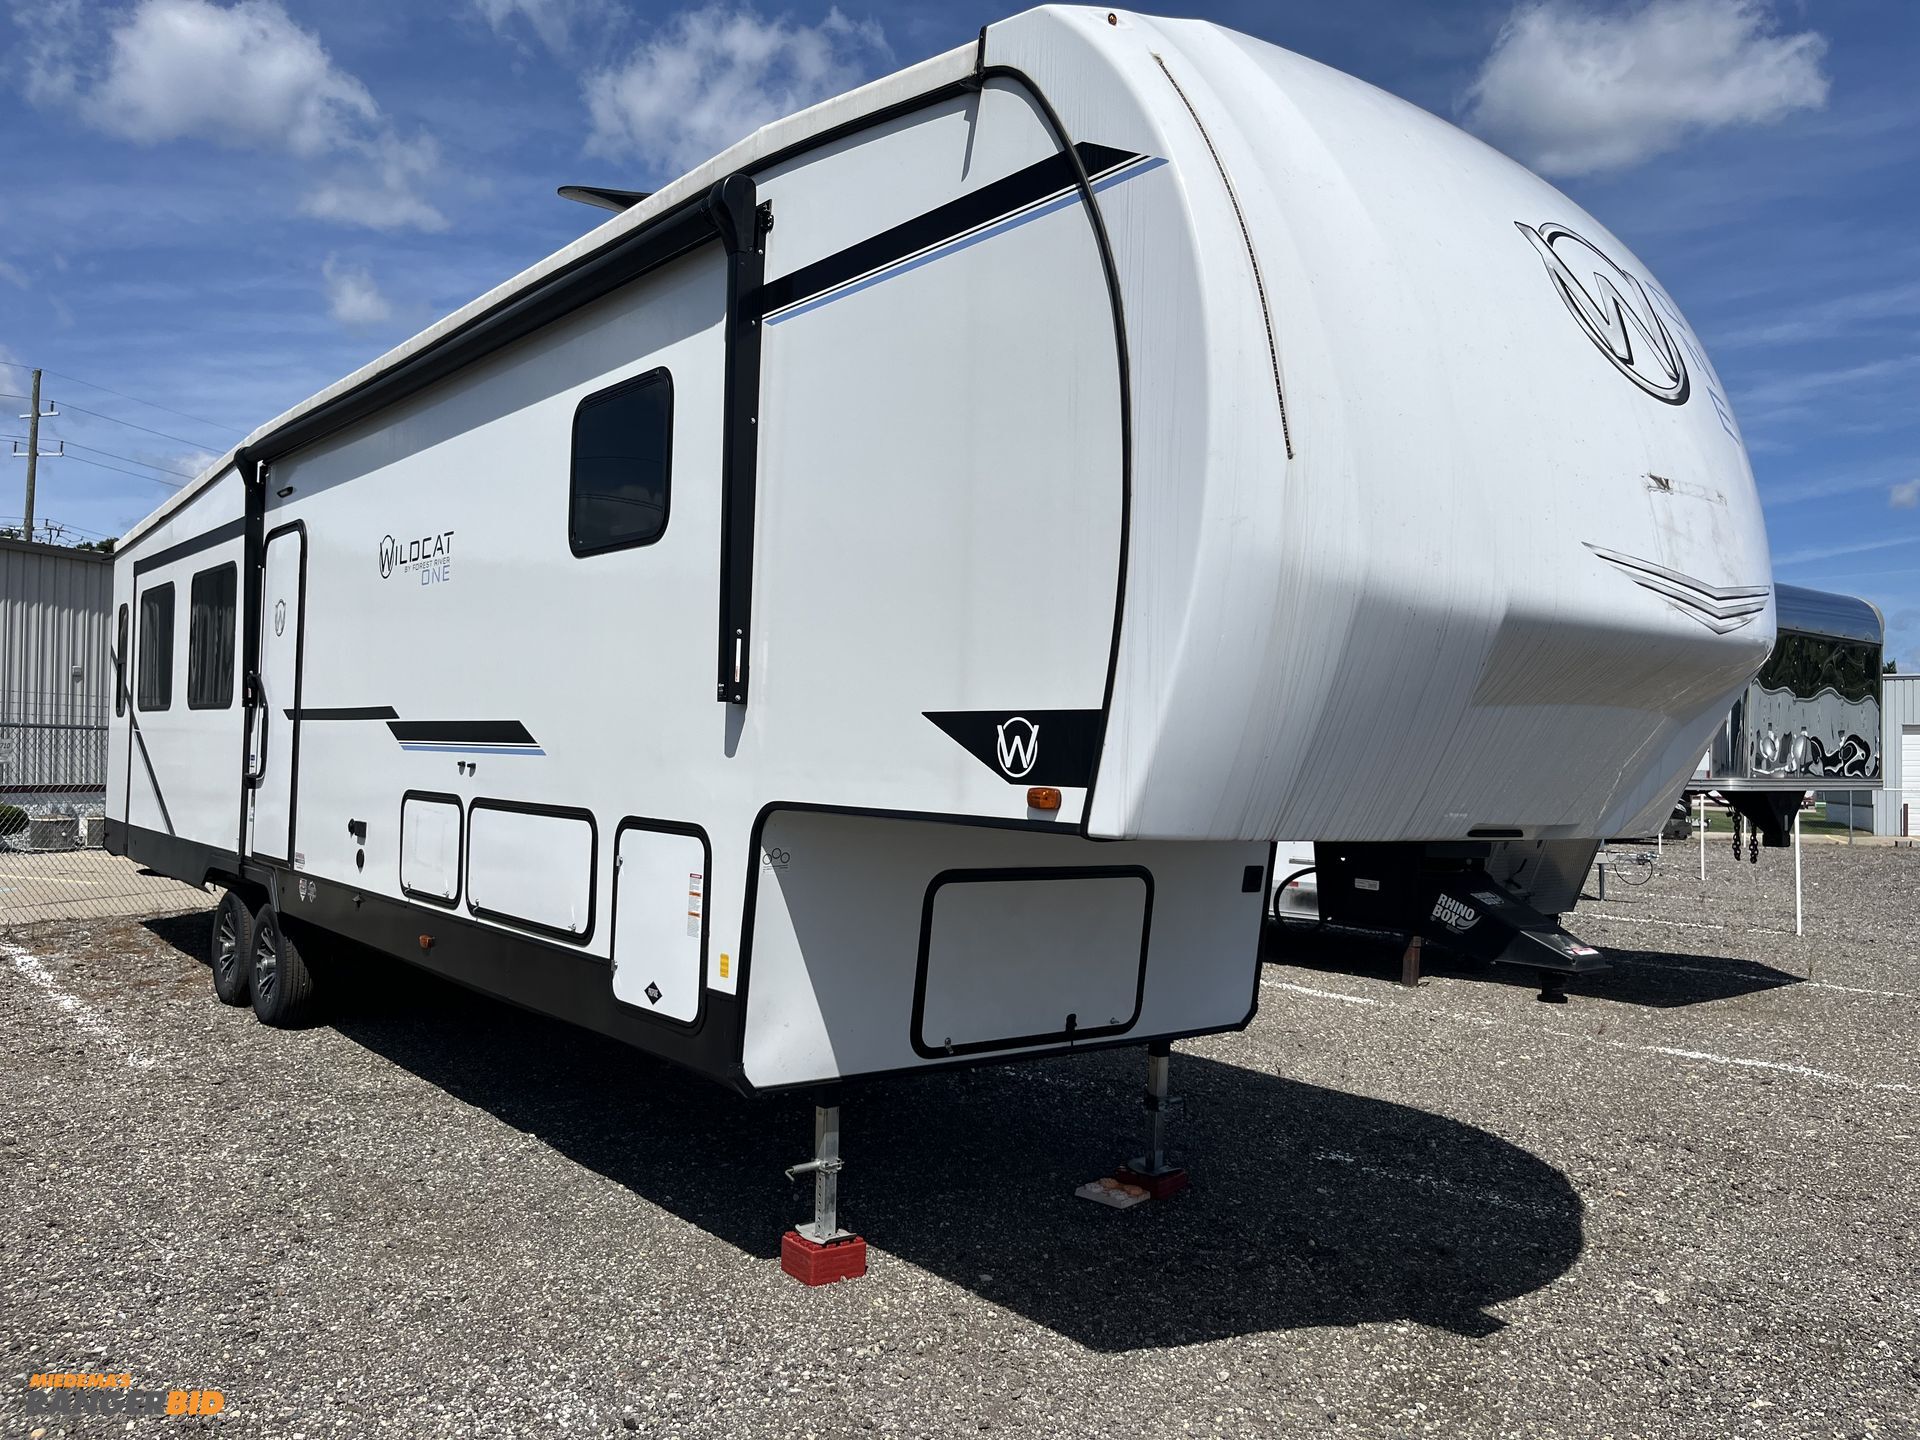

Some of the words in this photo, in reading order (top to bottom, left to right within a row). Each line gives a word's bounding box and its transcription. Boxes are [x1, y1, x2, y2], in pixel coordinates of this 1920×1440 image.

[379, 530, 454, 579] WILDCAT
[404, 565, 411, 573] BY
[413, 560, 433, 571] FOREST
[434, 556, 451, 567] RIVER
[421, 565, 450, 586] ONE
[997, 717, 1040, 778] W
[1432, 904, 1459, 926] BOX
[1437, 893, 1475, 921] RHINO
